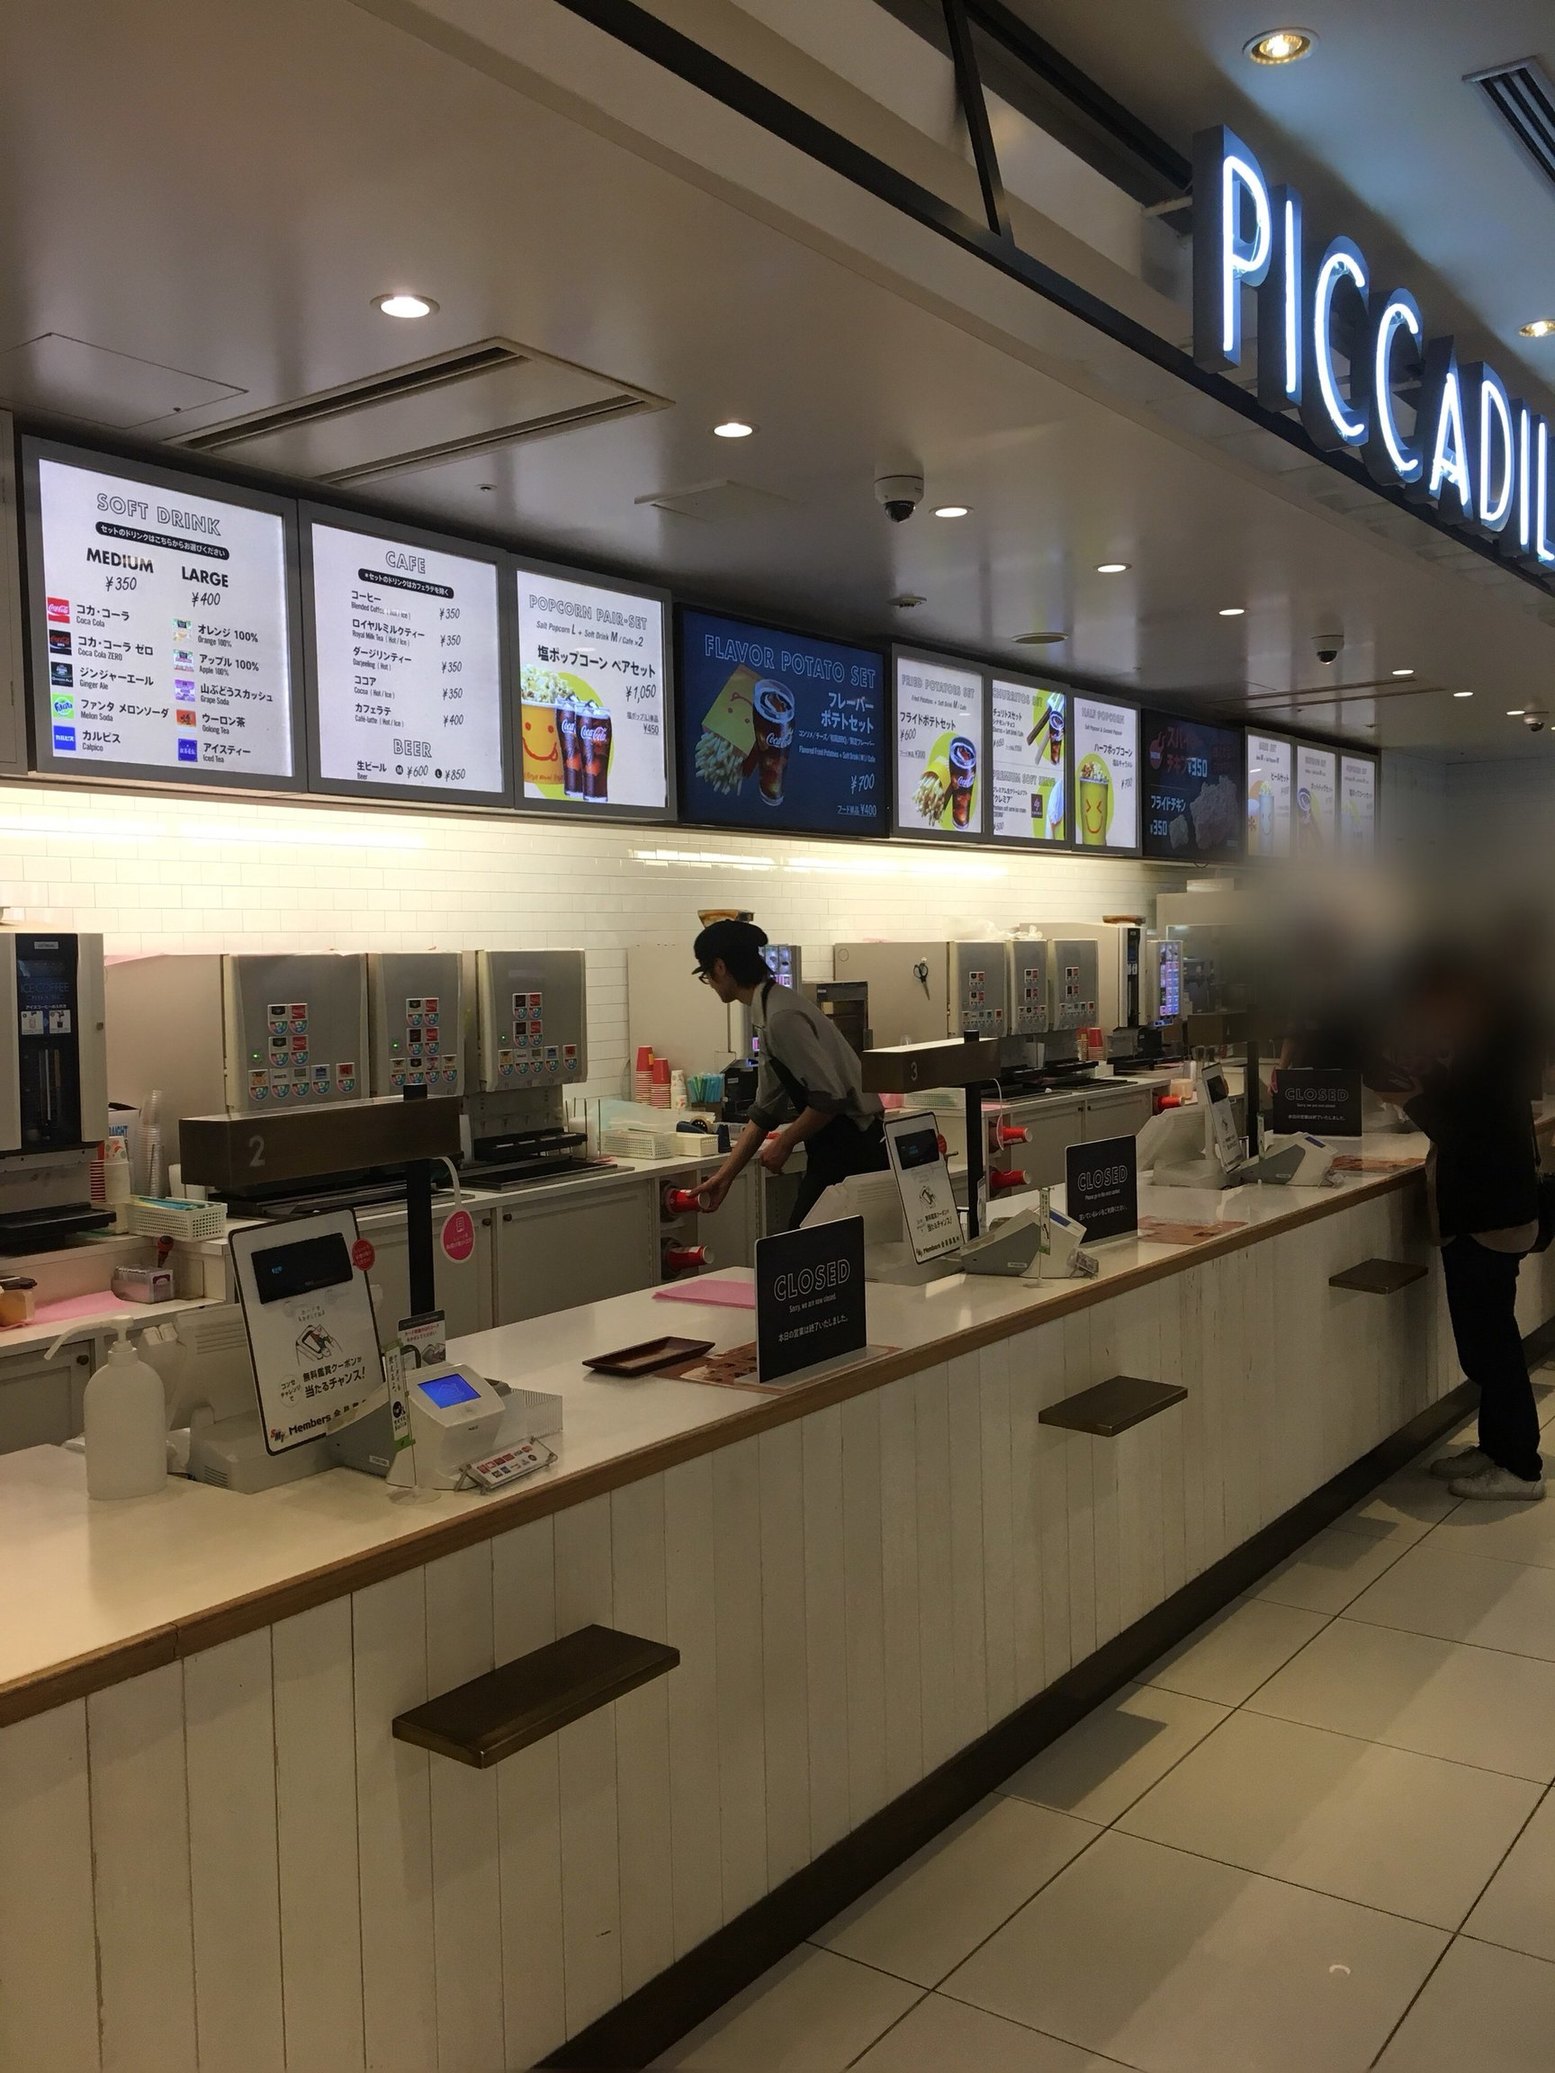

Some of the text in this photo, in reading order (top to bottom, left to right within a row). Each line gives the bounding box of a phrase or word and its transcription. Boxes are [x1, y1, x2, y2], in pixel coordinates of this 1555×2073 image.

[97, 493, 221, 536] SOFT DRINK
[100, 524, 226, 557] セットのドリンクはこちらからお選びください
[86, 548, 229, 588] MEDIUM LARGE
[385, 551, 426, 574] CAFE
[105, 576, 221, 608] ¥350 ¥400
[351, 590, 381, 603] コーヒー
[76, 604, 130, 621] コカ・コーラ
[439, 607, 460, 620] ¥350
[529, 594, 592, 621] POPCORN
[76, 615, 105, 628] Coca Cola
[352, 619, 425, 638] ロイヤルミルクティー
[536, 621, 547, 631] Salt
[548, 623, 570, 635] Popcorn
[198, 624, 259, 643] オレンジ 100%
[440, 634, 461, 647] ¥350
[78, 636, 131, 652] コカ・コーラ
[135, 642, 154, 656] ゼロ
[78, 648, 123, 661] Coca Cola ZERO
[353, 645, 412, 664] ダージリンティー
[199, 654, 259, 672] アップル 100%
[199, 665, 214, 676] Apple
[441, 661, 463, 674] ¥350
[537, 645, 656, 679] 塩ポップコーン ペアセット
[705, 634, 876, 688] FLAVOR POTATO SET
[79, 666, 154, 686] ジンジャーエール
[79, 679, 109, 691] Ginger Ale
[354, 675, 377, 687] ココア
[200, 684, 273, 702] 山ぶどうスカッシュ
[200, 695, 229, 706] Grape Soda
[442, 687, 463, 701] ¥350
[626, 684, 656, 703] ¥1,050
[828, 692, 874, 712] フレーバー
[80, 698, 169, 718] ファンタ メロンソーダ
[80, 711, 113, 722] Melon Soda
[355, 703, 391, 716] カフェラテ
[202, 713, 245, 727] ウーロン茶
[443, 714, 464, 727] ¥400
[821, 710, 874, 734] ポテトセット
[900, 711, 956, 731] フライドポテトセット
[82, 730, 121, 744] カルピス
[202, 725, 229, 735] Oolong Tea
[203, 742, 251, 755] アイスティー
[393, 738, 432, 758] BEER
[203, 754, 225, 764] Iced Tea
[357, 761, 387, 772] 生ビール
[407, 765, 428, 779] ¥600
[445, 769, 466, 782] ¥850
[850, 773, 875, 794] ¥700
[910, 1061, 919, 1080] 3
[1285, 1087, 1349, 1102] CLOSED
[248, 1135, 266, 1167] 2
[1078, 1165, 1128, 1191] CLOSED
[774, 1259, 851, 1301] CLOSED
[289, 1415, 331, 1436] Members
